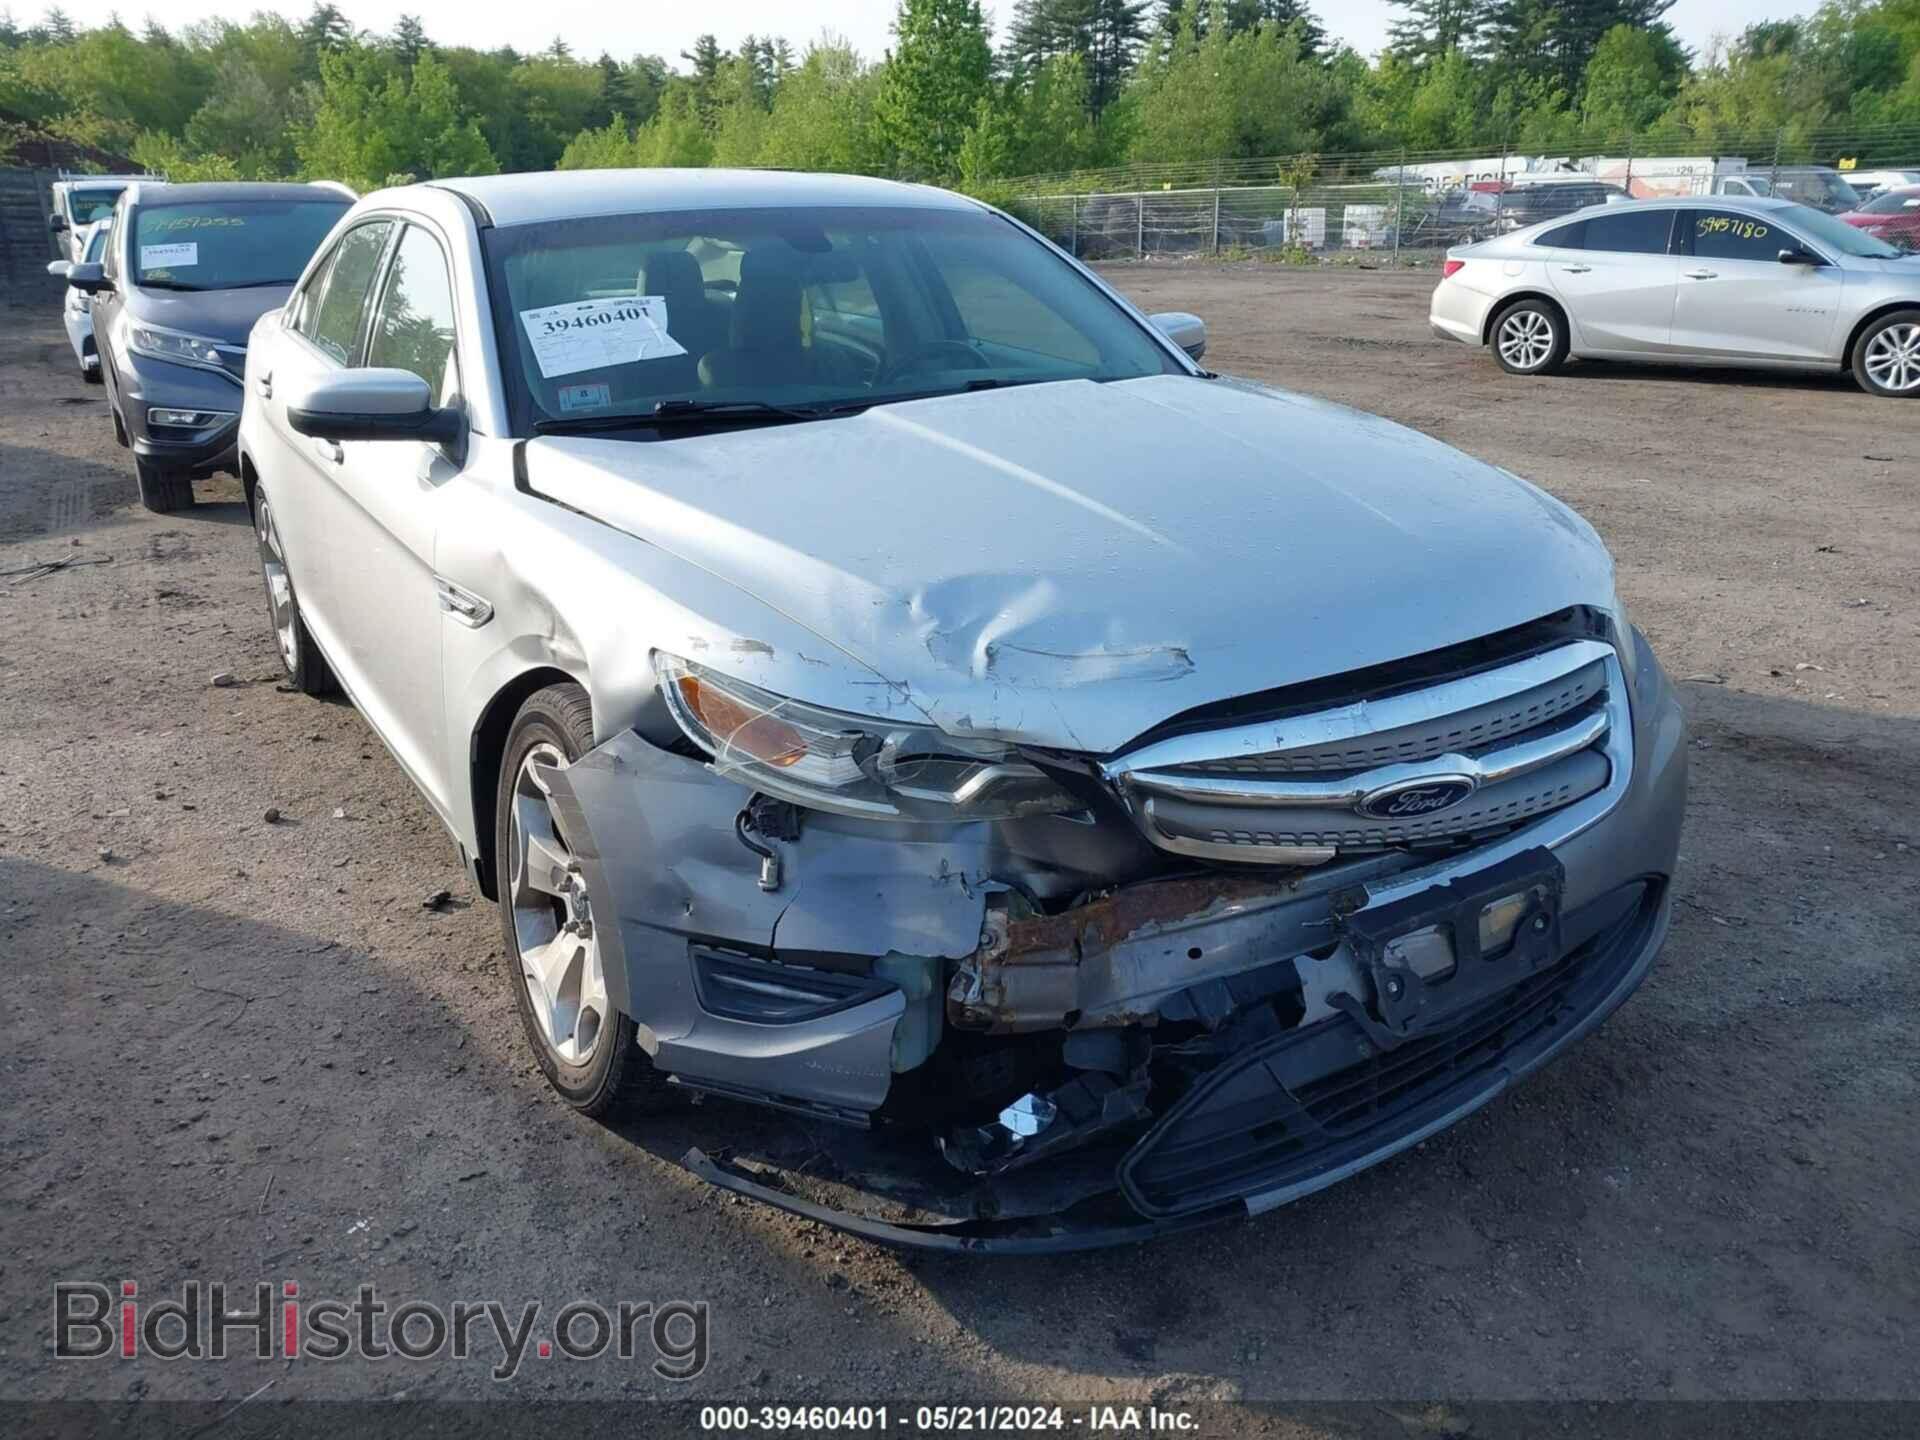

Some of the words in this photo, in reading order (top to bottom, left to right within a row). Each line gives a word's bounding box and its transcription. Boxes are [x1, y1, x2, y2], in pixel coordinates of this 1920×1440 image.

[1696, 216, 1768, 238] 39457180
[543, 307, 651, 335] 39460401
[1388, 787, 1453, 814] Ford
